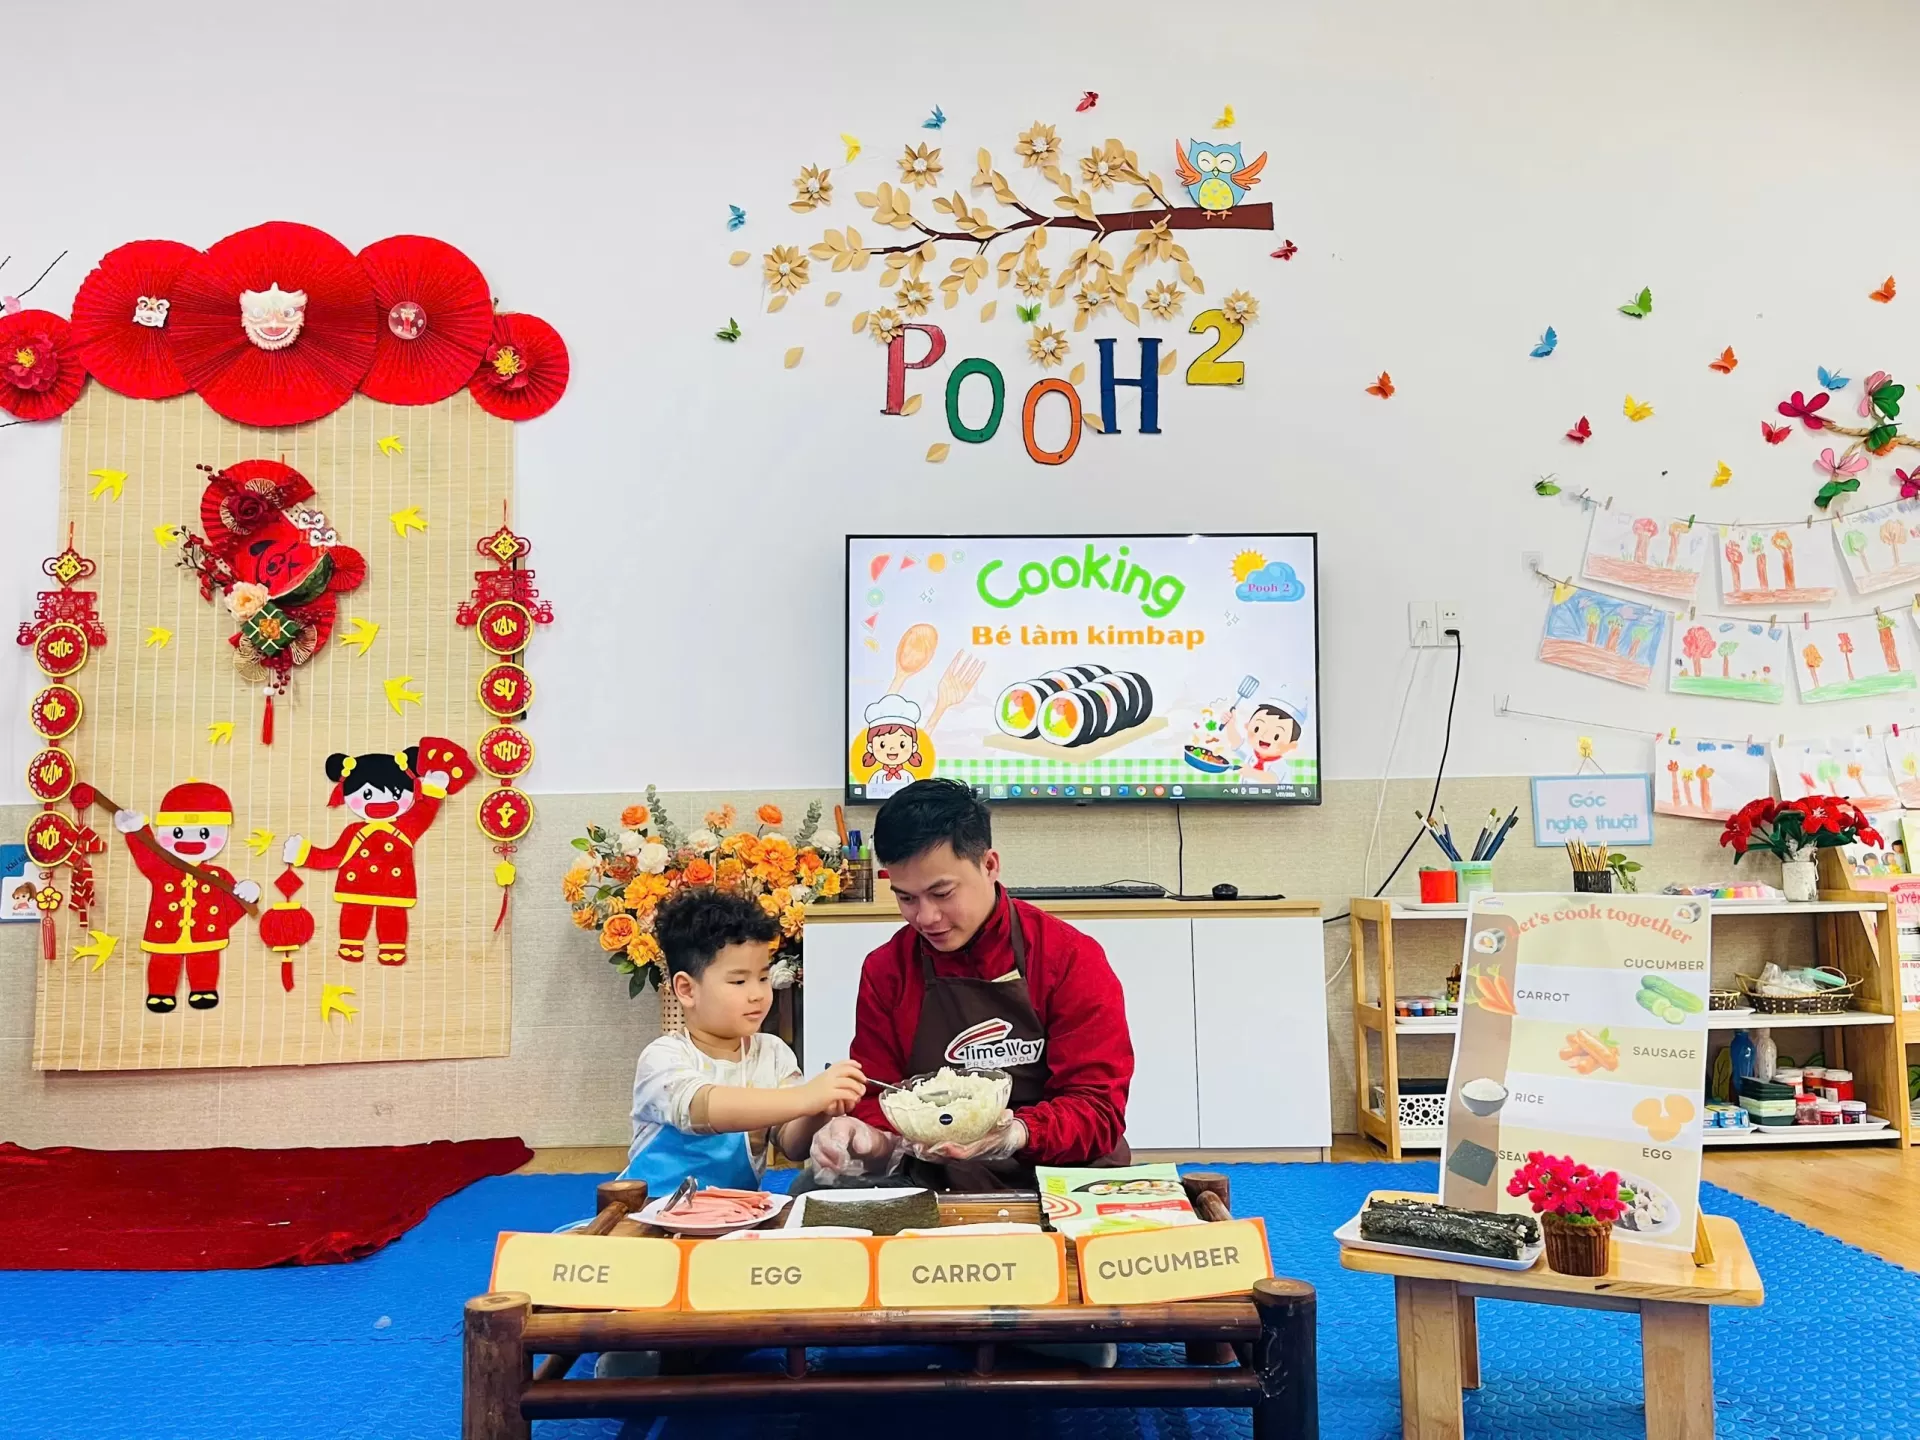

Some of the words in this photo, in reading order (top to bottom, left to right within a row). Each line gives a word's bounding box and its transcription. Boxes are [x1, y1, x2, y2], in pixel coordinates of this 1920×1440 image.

[880, 323, 1163, 466] POOH
[1186, 308, 1245, 386] 2
[976, 543, 1187, 619] Cooking
[1247, 583, 1279, 593] Pooh
[1283, 583, 1290, 593] 2
[48, 637, 74, 658] CHÚC
[971, 624, 1012, 646] Bé
[1020, 624, 1079, 646] làm
[1087, 624, 1206, 651] kimbap
[492, 677, 518, 701] SỰ
[1568, 790, 1607, 808] Góc
[1545, 814, 1589, 834] nghệ
[1596, 813, 1639, 832] thuật
[1507, 911, 1551, 941] Let's
[1553, 903, 1602, 922] cook
[1606, 906, 1693, 945] together
[1623, 958, 1705, 970] CUCUMBER
[1516, 989, 1570, 1002] CARROT
[963, 1041, 1043, 1060] TimeWay
[1632, 1046, 1697, 1059] SAUSAGE
[1514, 1092, 1545, 1104] RICE
[1642, 1147, 1673, 1161] EGG
[911, 1261, 1018, 1285] CARROT
[1097, 1245, 1241, 1281] CUCUMBER
[552, 1263, 611, 1285] RICE
[749, 1265, 803, 1287] EGG
